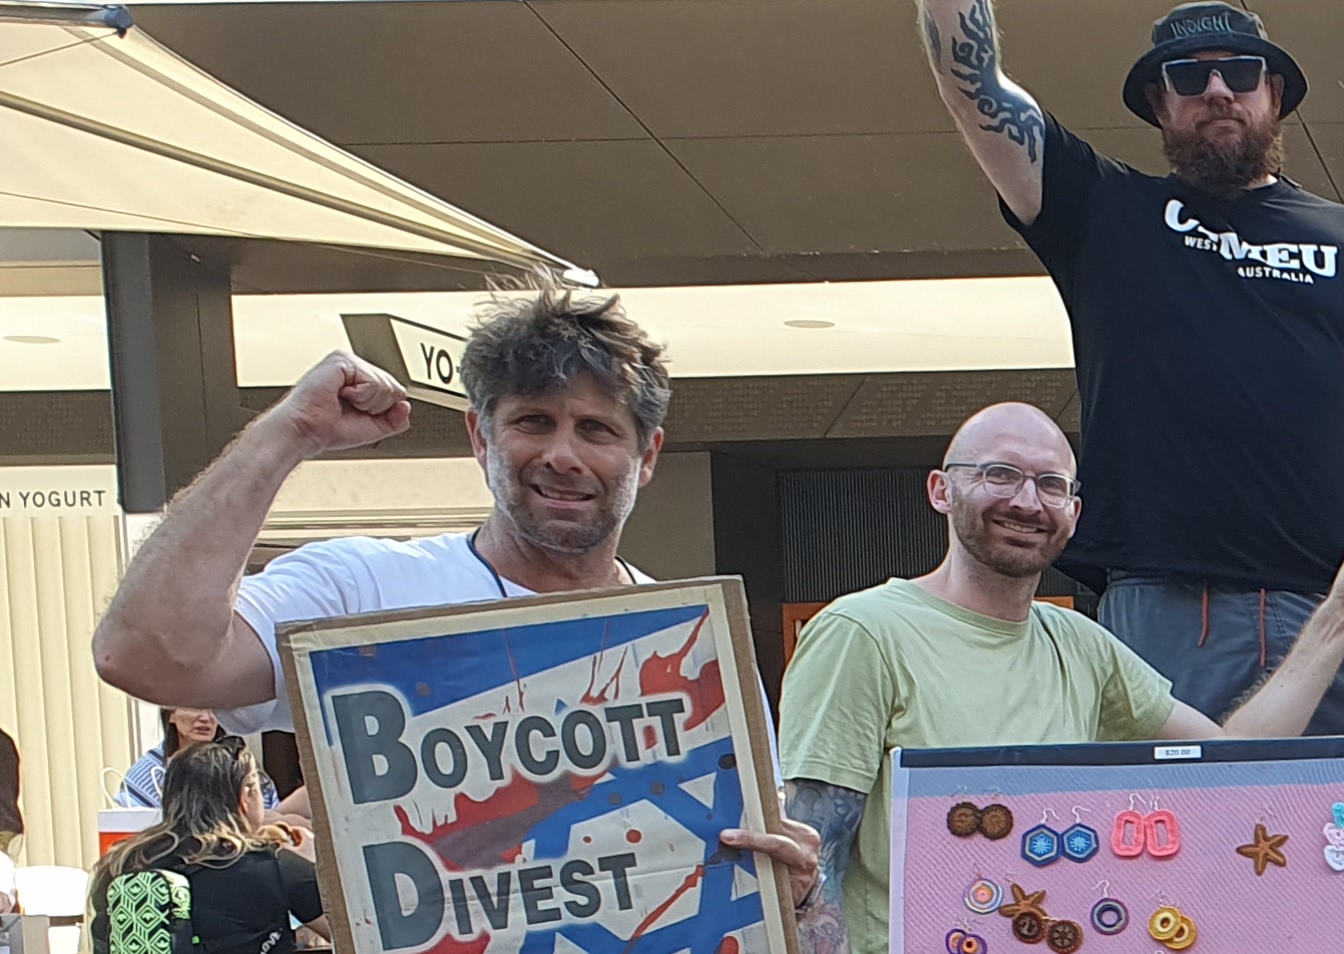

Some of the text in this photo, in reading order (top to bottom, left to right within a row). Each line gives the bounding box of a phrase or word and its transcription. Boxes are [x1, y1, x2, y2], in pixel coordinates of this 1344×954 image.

[1236, 266, 1315, 285] AUSTRALIA
[19, 490, 107, 508] YOGURT
[331, 689, 688, 805] BOYCOTT
[361, 841, 638, 952] DIVEST
